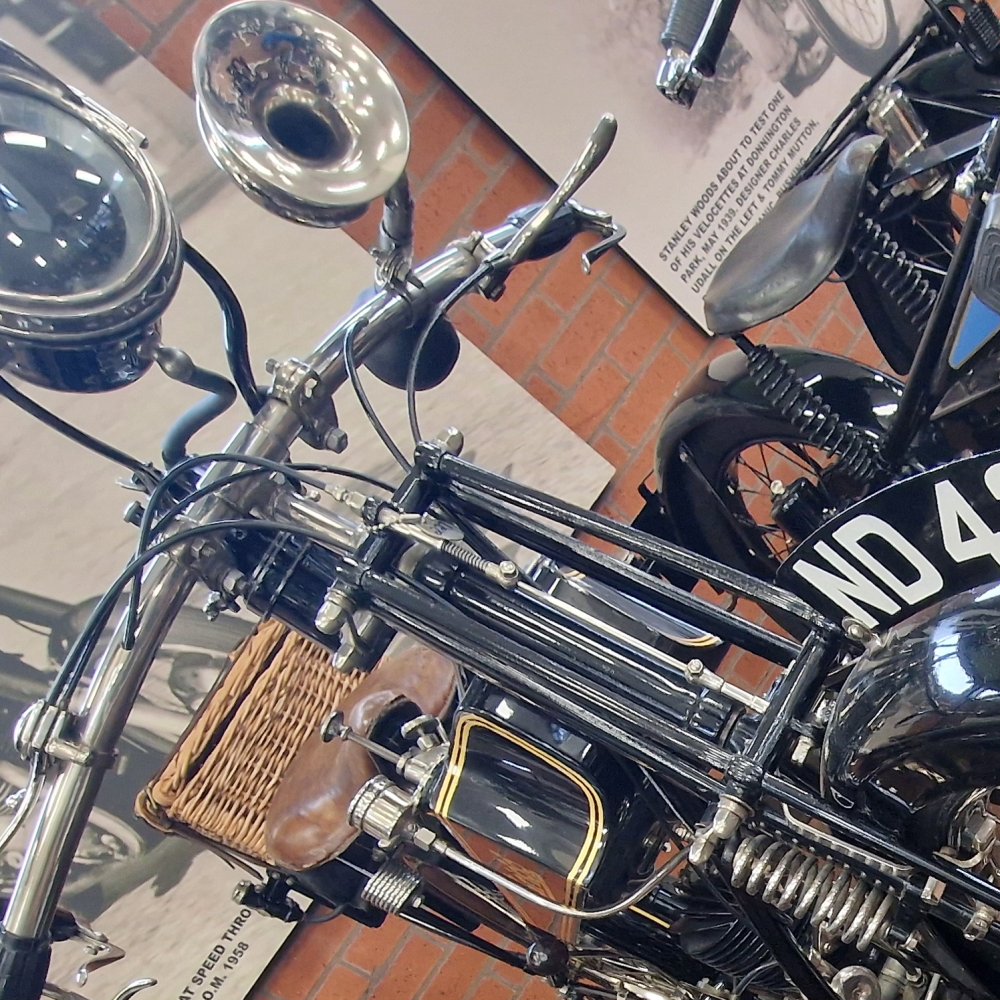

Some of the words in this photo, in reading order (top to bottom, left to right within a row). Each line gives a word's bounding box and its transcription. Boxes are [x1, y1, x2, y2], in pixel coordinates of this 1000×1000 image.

[659, 215, 692, 261] STANLEY
[690, 181, 718, 217] WOODS
[716, 148, 741, 183] ABOUT
[739, 135, 751, 149] TO
[749, 110, 768, 135] TEST
[768, 90, 784, 111] ONE
[670, 256, 681, 271] OF
[680, 238, 695, 257] HIS
[692, 178, 738, 238] VELOCETTES
[737, 164, 748, 180] AT
[746, 105, 792, 166] DONNINGTON
[680, 255, 705, 283] PARK,
[701, 230, 718, 254] MAY
[718, 208, 738, 231] 1939.
[735, 158, 771, 207] DESIGNER
[769, 117, 800, 160] CHARLES
[691, 262, 716, 293] UDALL
[714, 245, 727, 261] ON
[724, 225, 742, 245] THE
[739, 200, 758, 226] LEFT
[757, 193, 765, 202] &
[763, 157, 788, 192] TOMMY
[793, 513, 944, 628] ND
[191, 944, 225, 985] SPEED
[220, 908, 251, 941] THRO
[223, 941, 249, 969] 1958
